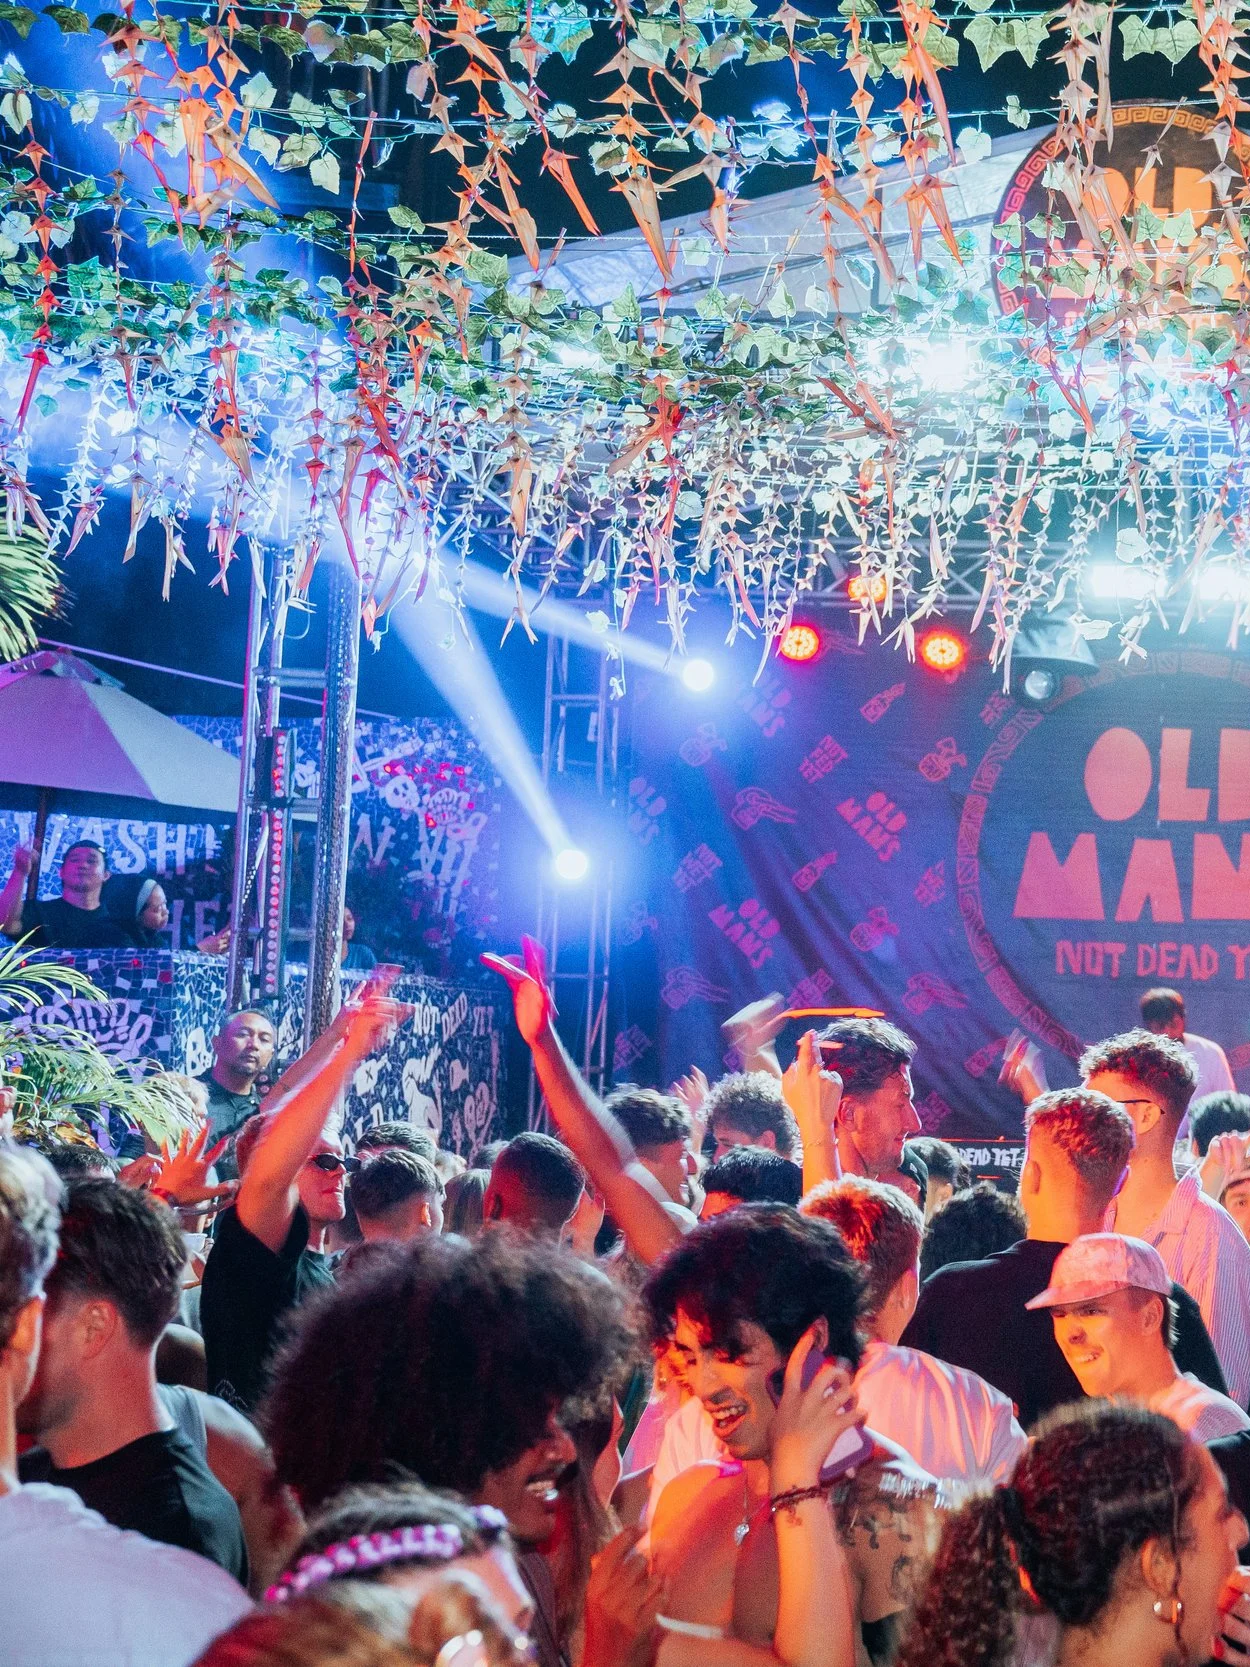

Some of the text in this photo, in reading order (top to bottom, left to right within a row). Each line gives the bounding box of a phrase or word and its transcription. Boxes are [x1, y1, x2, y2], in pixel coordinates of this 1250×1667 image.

[866, 791, 907, 832] OLD
[738, 899, 781, 939] OLD
[1055, 940, 1127, 979] NOT
[1137, 942, 1220, 981] DEAD
[413, 1001, 441, 1037] NOT
[441, 991, 468, 1043] DEAD
